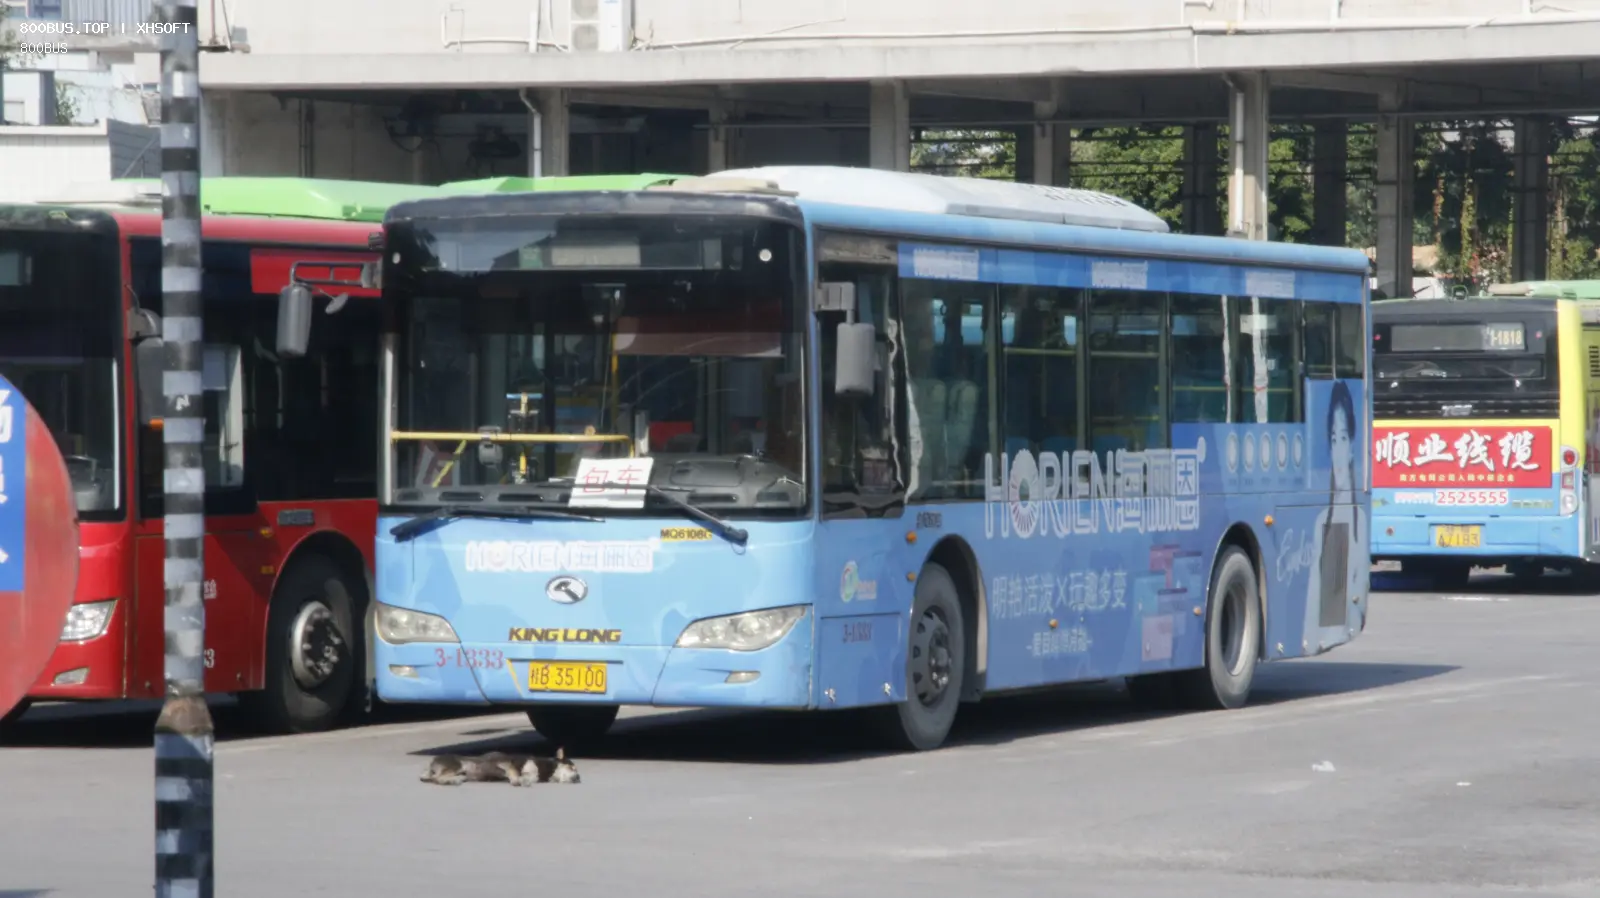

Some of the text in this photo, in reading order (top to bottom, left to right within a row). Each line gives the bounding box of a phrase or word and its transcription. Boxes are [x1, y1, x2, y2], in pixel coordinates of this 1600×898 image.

[1375, 429, 1540, 472] 顺业线缆
[583, 464, 643, 495] 包车
[1437, 491, 1508, 504] 2525555
[508, 627, 622, 643] KING LONG
[434, 647, 505, 669] 3-1333
